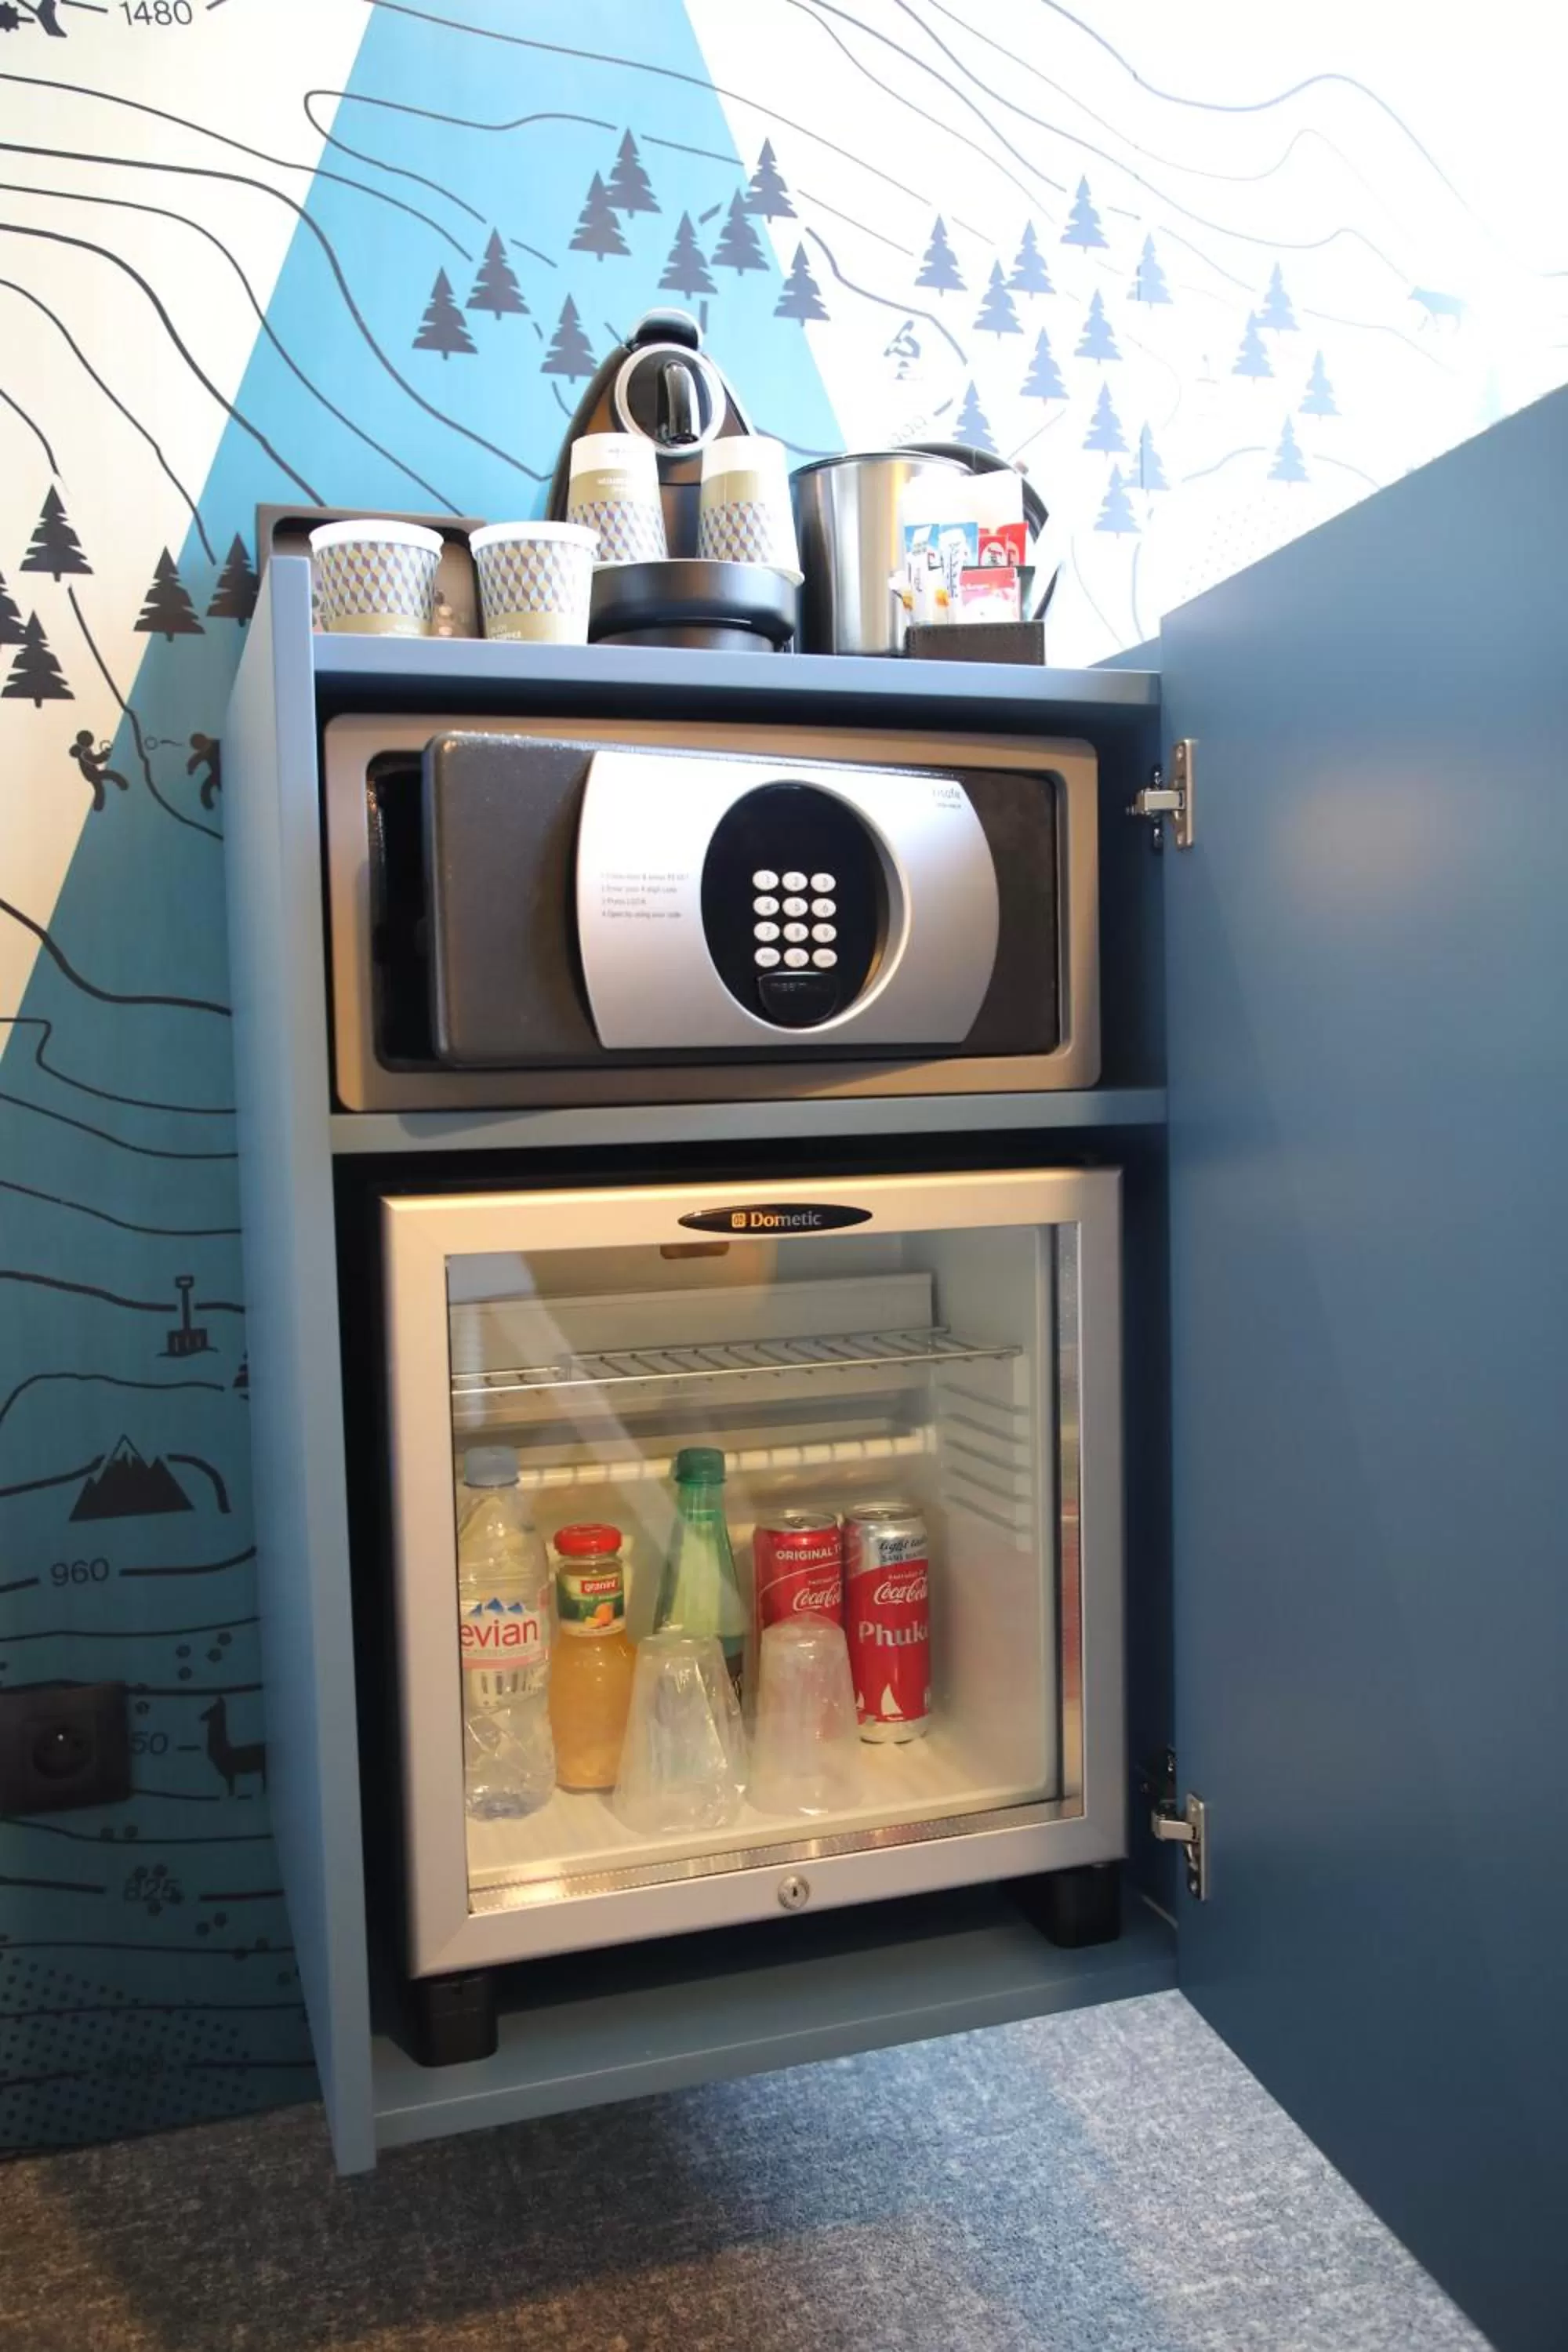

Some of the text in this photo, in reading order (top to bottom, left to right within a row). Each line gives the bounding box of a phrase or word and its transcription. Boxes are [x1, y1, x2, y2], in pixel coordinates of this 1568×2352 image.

[118, 0, 193, 25] 1480
[750, 1210, 822, 1227] Dometic
[776, 1547, 833, 1560] ORIGINAL
[50, 1558, 110, 1587] 960
[460, 1619, 539, 1648] evian
[858, 1620, 929, 1647] Phuk
[130, 1731, 169, 1756] 50
